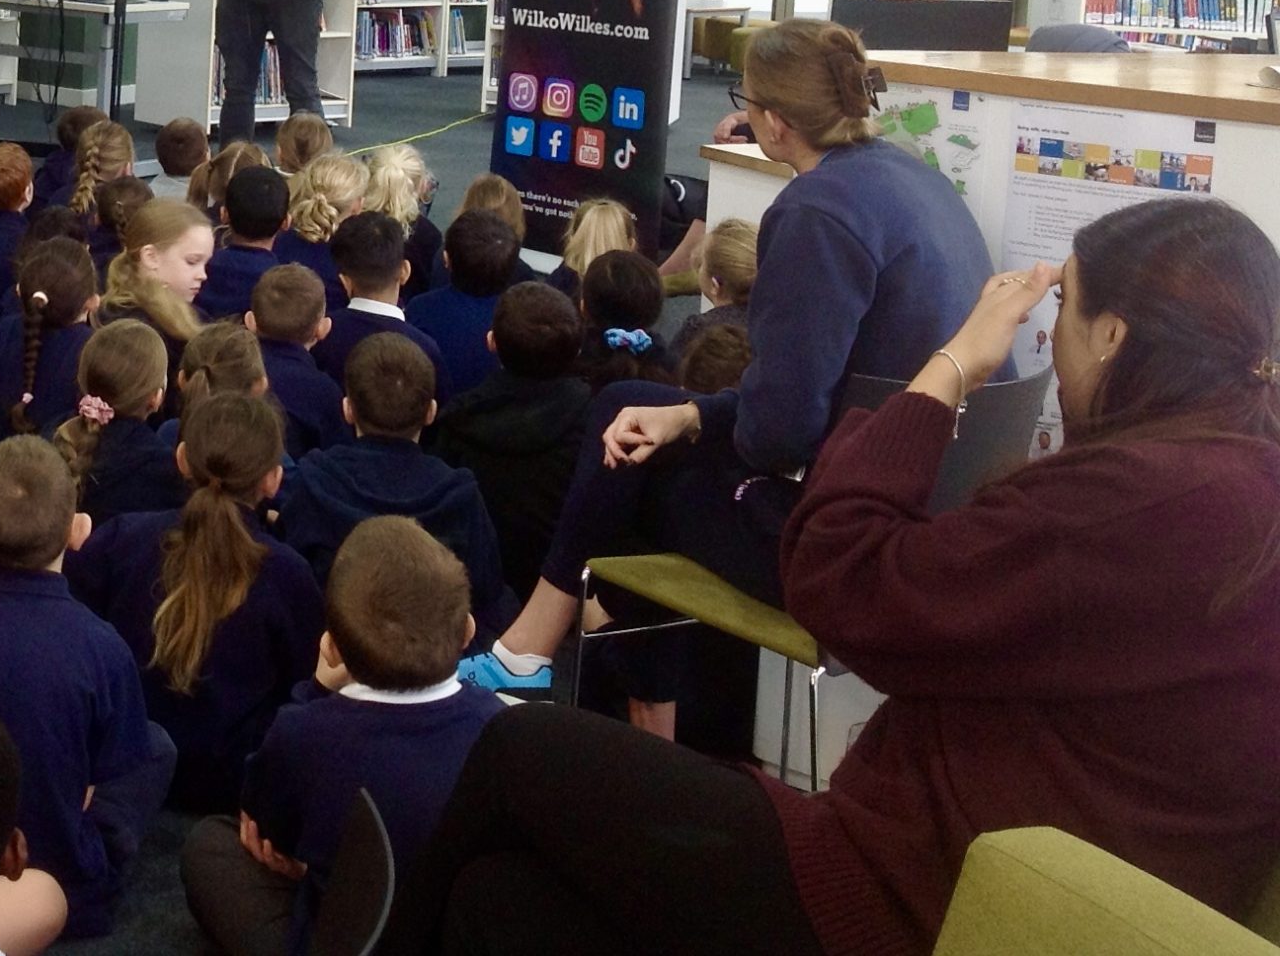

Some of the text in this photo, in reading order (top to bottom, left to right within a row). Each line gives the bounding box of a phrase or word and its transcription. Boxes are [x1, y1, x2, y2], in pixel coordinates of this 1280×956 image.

[512, 7, 650, 41] WilkoWilkes.com
[618, 95, 639, 121] in
[583, 130, 598, 146] You
[581, 147, 599, 163] Tube
[526, 190, 552, 202] there's
[552, 197, 563, 205] no
[545, 207, 558, 217] got
